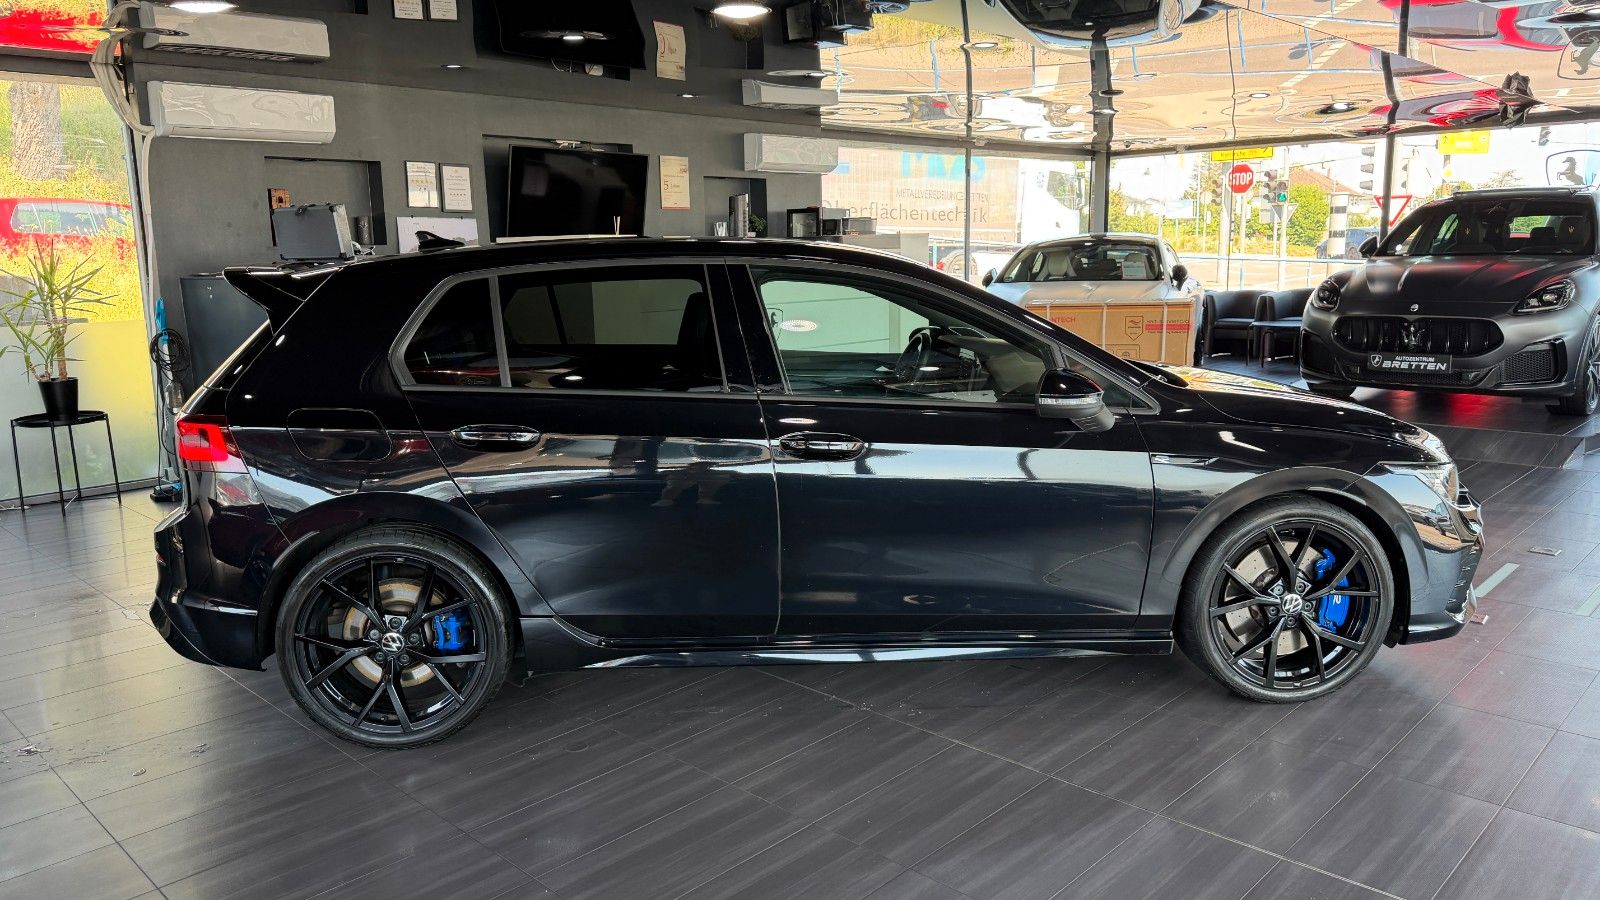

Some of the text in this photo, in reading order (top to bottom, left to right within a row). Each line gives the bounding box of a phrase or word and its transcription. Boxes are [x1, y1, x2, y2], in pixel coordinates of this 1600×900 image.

[1229, 171, 1252, 186] STOP
[1395, 355, 1435, 363] AUTOZENTRUM
[1382, 360, 1447, 371] BRETTEN
